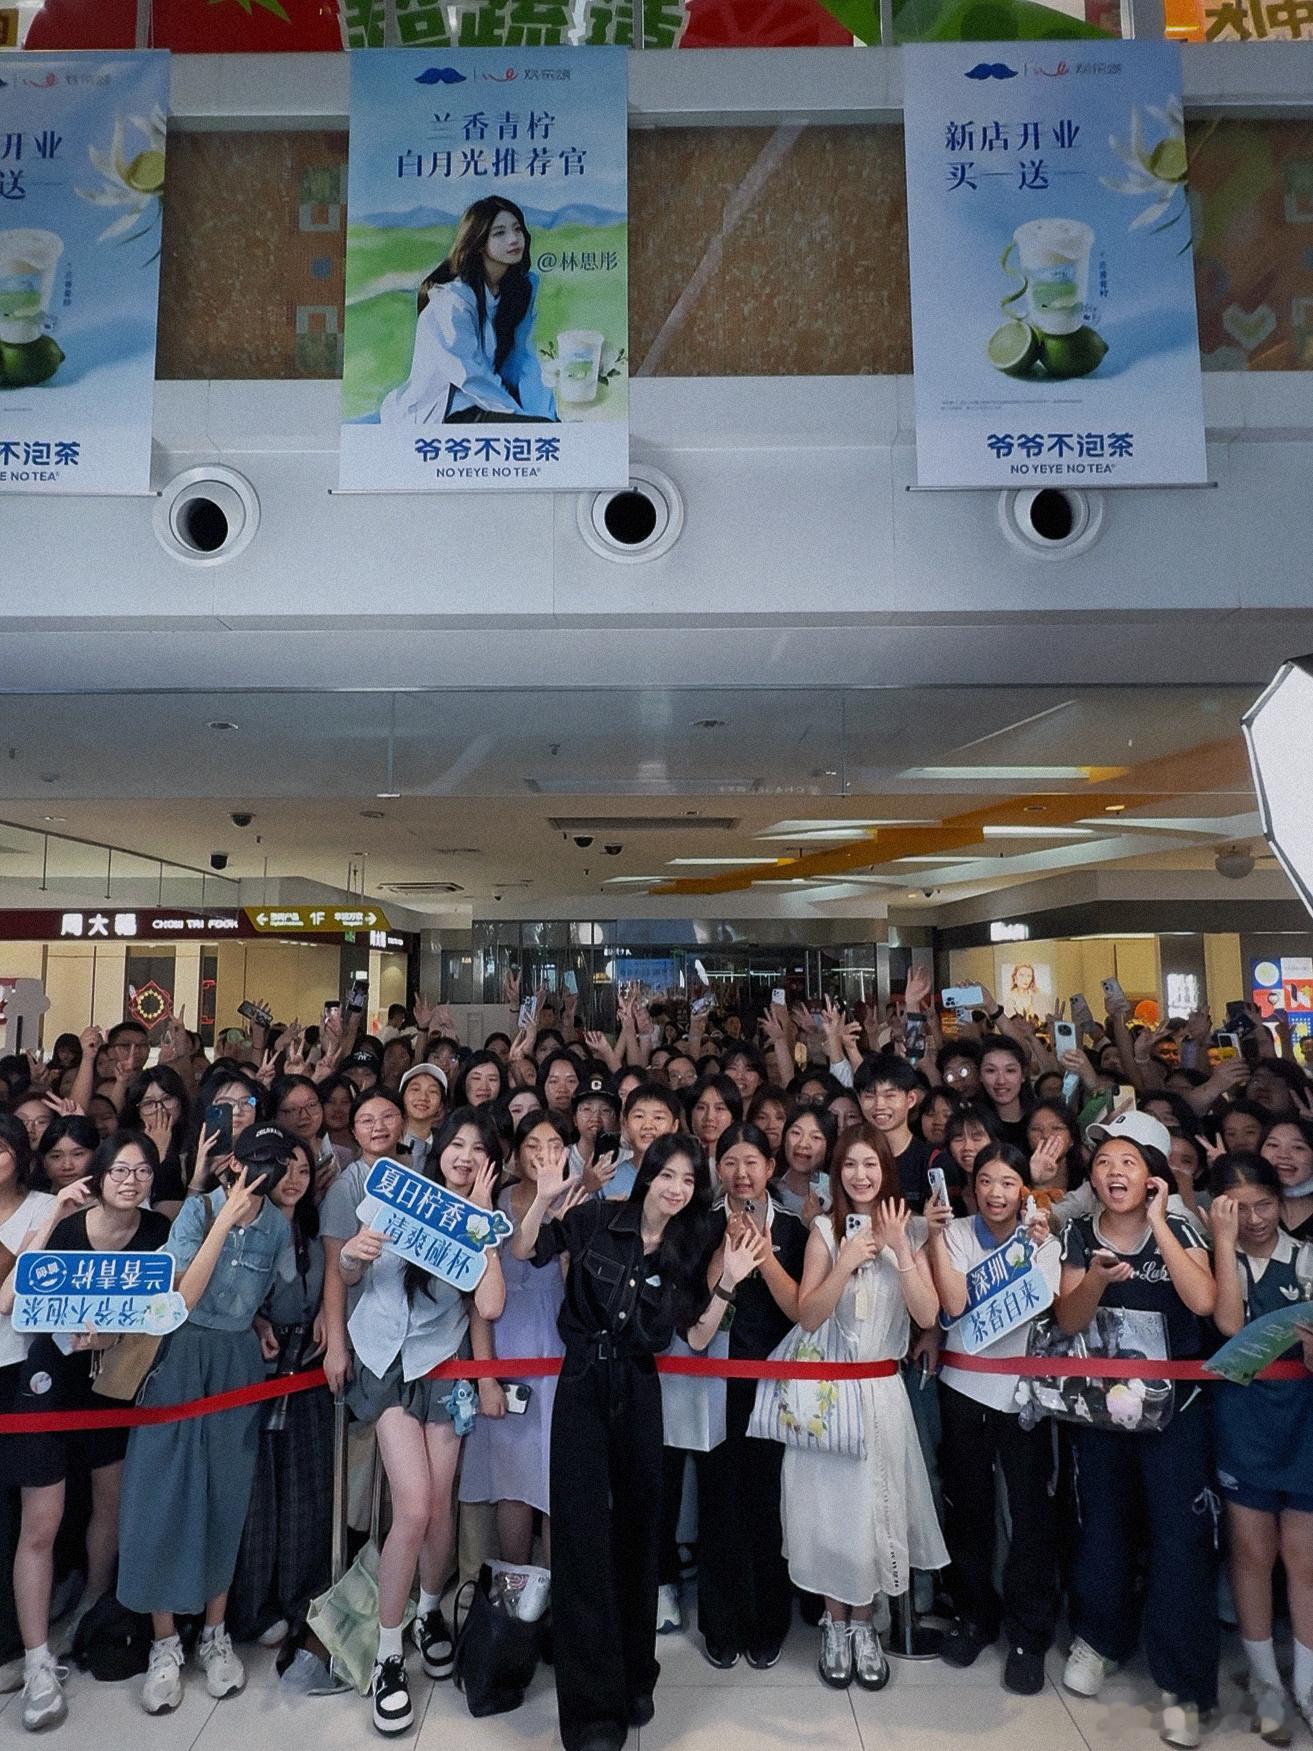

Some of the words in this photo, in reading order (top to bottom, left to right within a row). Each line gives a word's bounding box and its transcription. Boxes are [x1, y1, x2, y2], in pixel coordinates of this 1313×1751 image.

[427, 111, 556, 141] 兰香青柠
[945, 120, 1080, 151] 新店开业
[396, 147, 588, 178] 白月光推荐官
[944, 159, 1088, 191] 买一送一
[537, 251, 618, 272] @林思彤
[0, 441, 80, 465] 不泡茶
[414, 437, 560, 462] 爷爷不泡茶
[987, 432, 1134, 459] 爷爷不泡茶
[10, 471, 30, 481] NO
[436, 468, 455, 478] NO
[457, 468, 489, 478] YEYE
[492, 467, 511, 477] NO
[1010, 464, 1029, 474] NO
[1032, 464, 1063, 474] YEYE
[1067, 464, 1085, 473] NO
[309, 911, 325, 926] 1F
[373, 1164, 466, 1232] 夏日柠香
[382, 1212, 473, 1280] 清爽碰杯
[71, 1258, 168, 1291] 兰香青柠
[21, 1296, 144, 1327] 爷爷不泡茶
[970, 1279, 1040, 1344] 茶香自来
